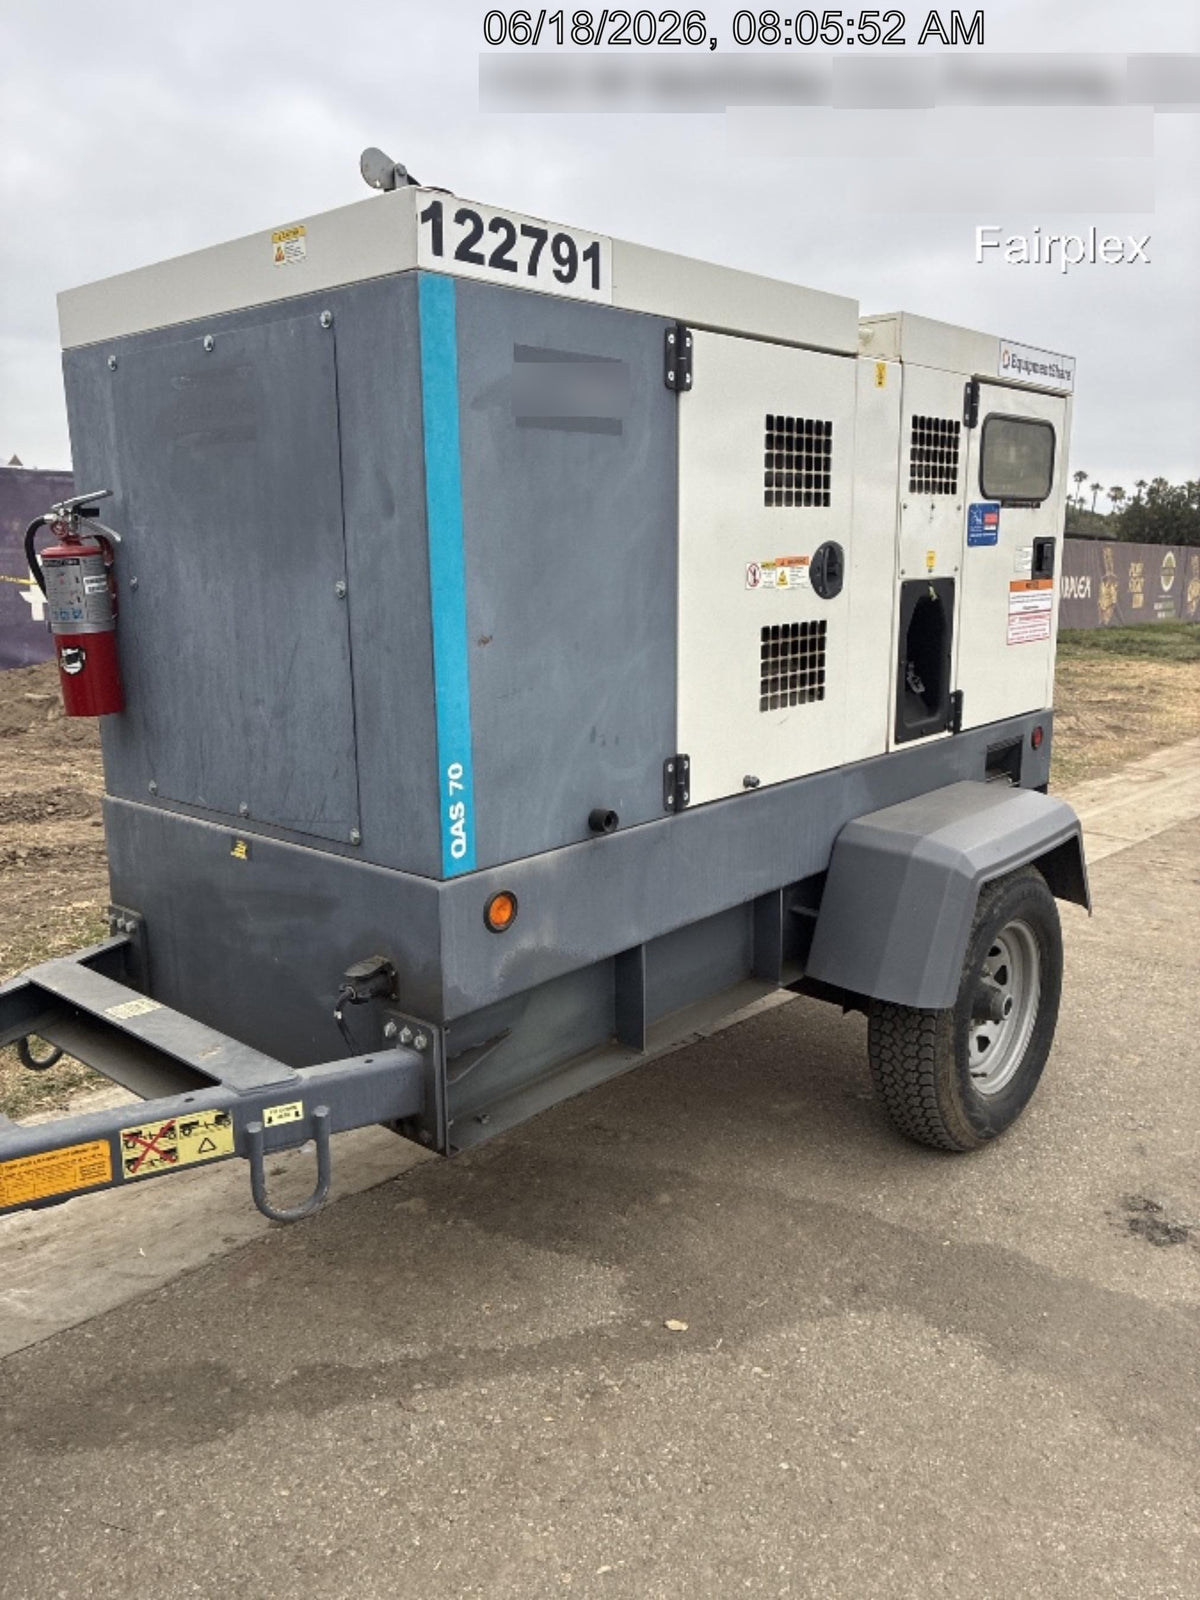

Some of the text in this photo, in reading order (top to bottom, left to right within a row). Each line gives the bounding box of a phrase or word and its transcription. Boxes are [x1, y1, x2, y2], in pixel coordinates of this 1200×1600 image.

[421, 200, 600, 290] 122791
[447, 762, 466, 859] QAS 70
